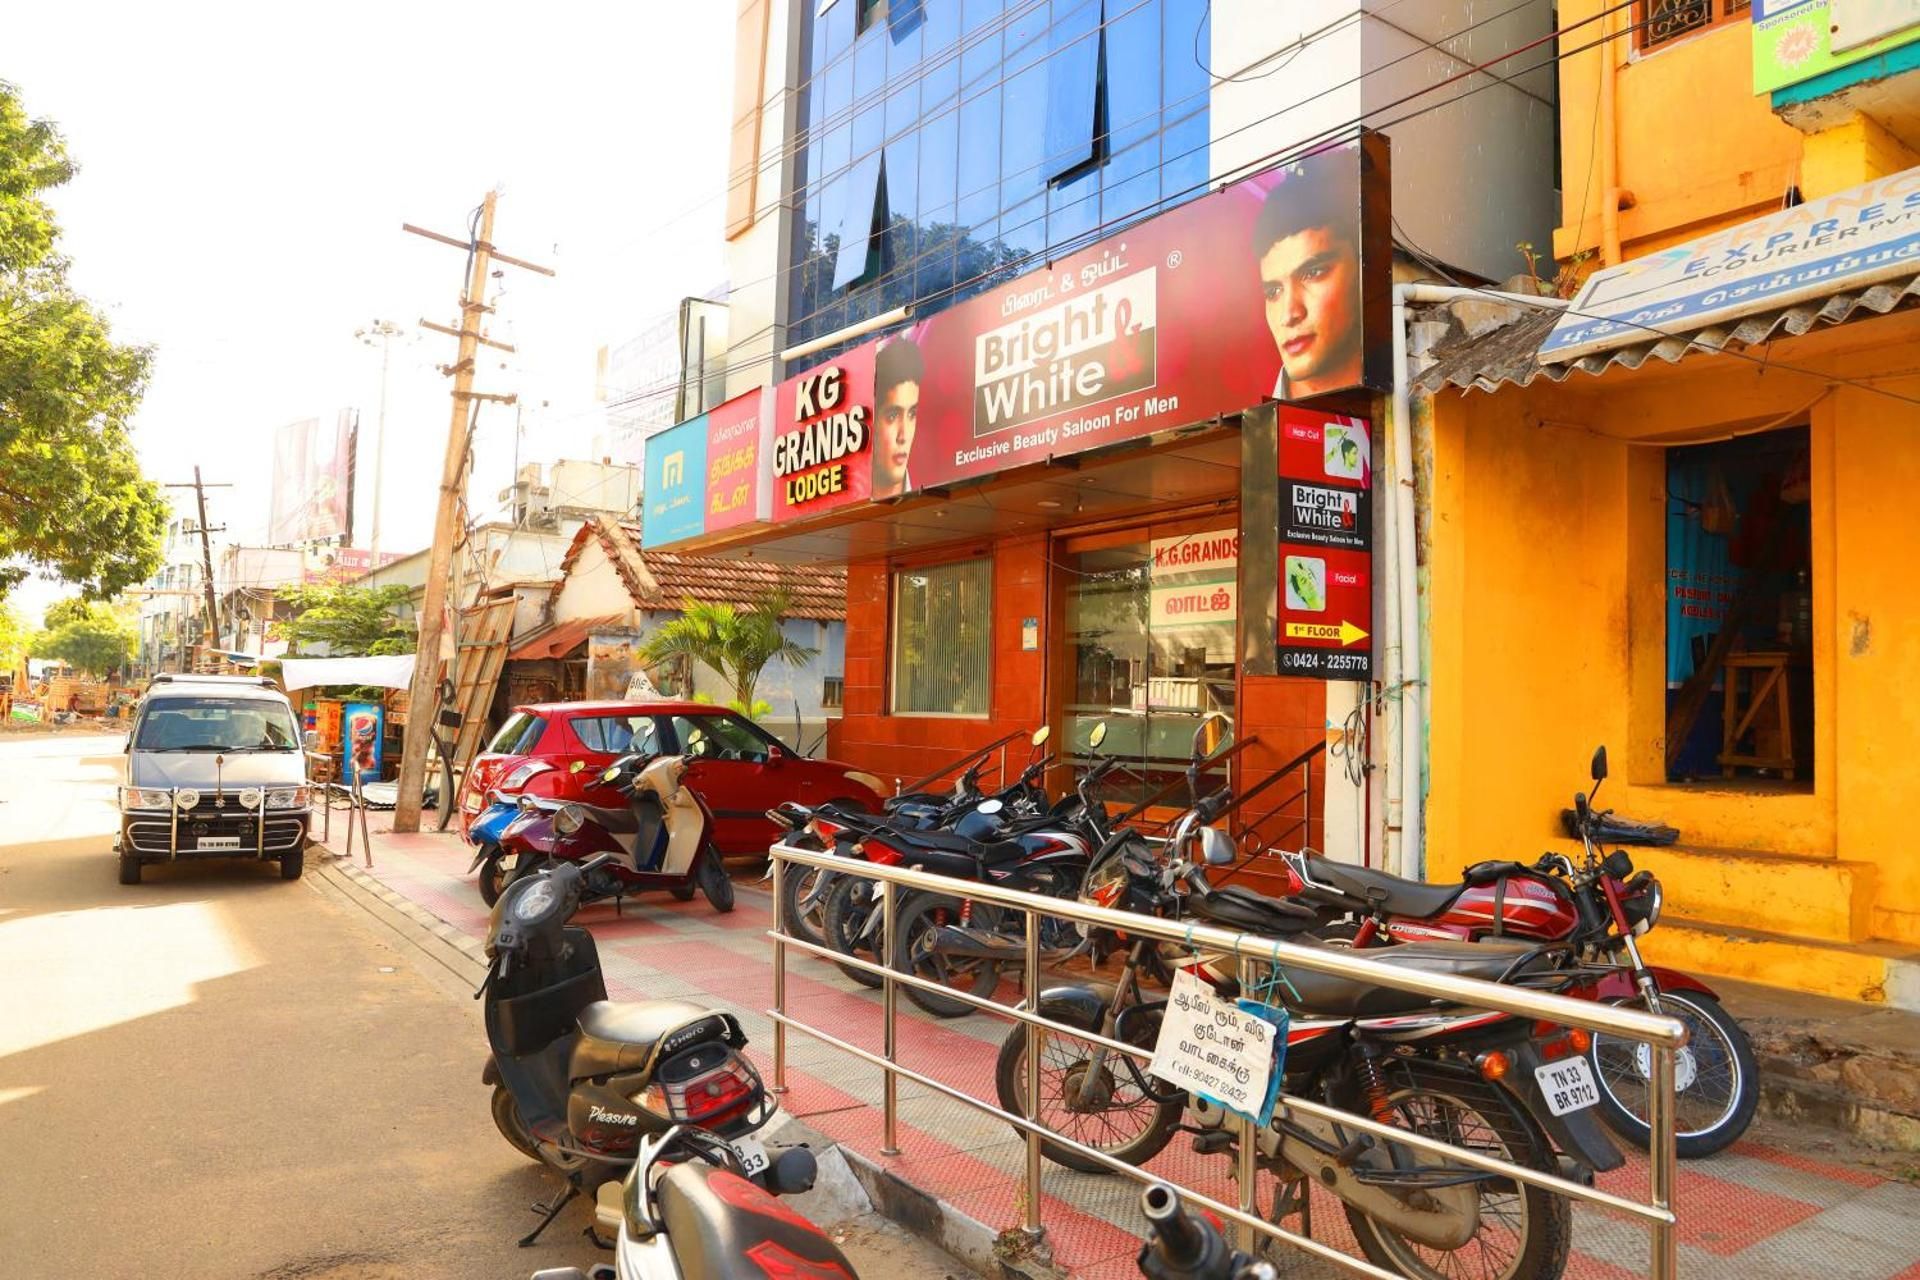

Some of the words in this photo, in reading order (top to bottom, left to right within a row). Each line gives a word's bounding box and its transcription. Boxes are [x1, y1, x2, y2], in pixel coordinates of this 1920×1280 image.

[1702, 226, 1860, 277] COURIER
[1059, 273, 1075, 293] &
[984, 293, 1108, 376] Bright
[794, 365, 844, 423] KG
[983, 359, 1106, 425] White
[772, 403, 868, 480] GRANDS
[955, 440, 1010, 466] Exclusive
[1013, 427, 1059, 451] Beauty
[1062, 413, 1111, 438] Saloon
[1115, 404, 1140, 425] For
[1144, 394, 1179, 417] Men
[785, 464, 843, 506] LODGE
[1296, 487, 1342, 509] Bright
[1296, 507, 1342, 528] White
[1287, 529, 1311, 541] Exclusive
[1311, 532, 1329, 544] Beauty
[1155, 537, 1239, 568] K.G.GRANDS
[1335, 572, 1356, 584] Facial
[1307, 626, 1341, 638] FLOOR
[1293, 653, 1318, 668] 0424
[1327, 654, 1368, 670] 2255778
[1551, 1069, 1569, 1089] TN
[1566, 1066, 1582, 1083] 33
[1554, 1089, 1573, 1110] BR
[1570, 1084, 1595, 1104] 9712
[588, 1105, 638, 1127] Pleasure
